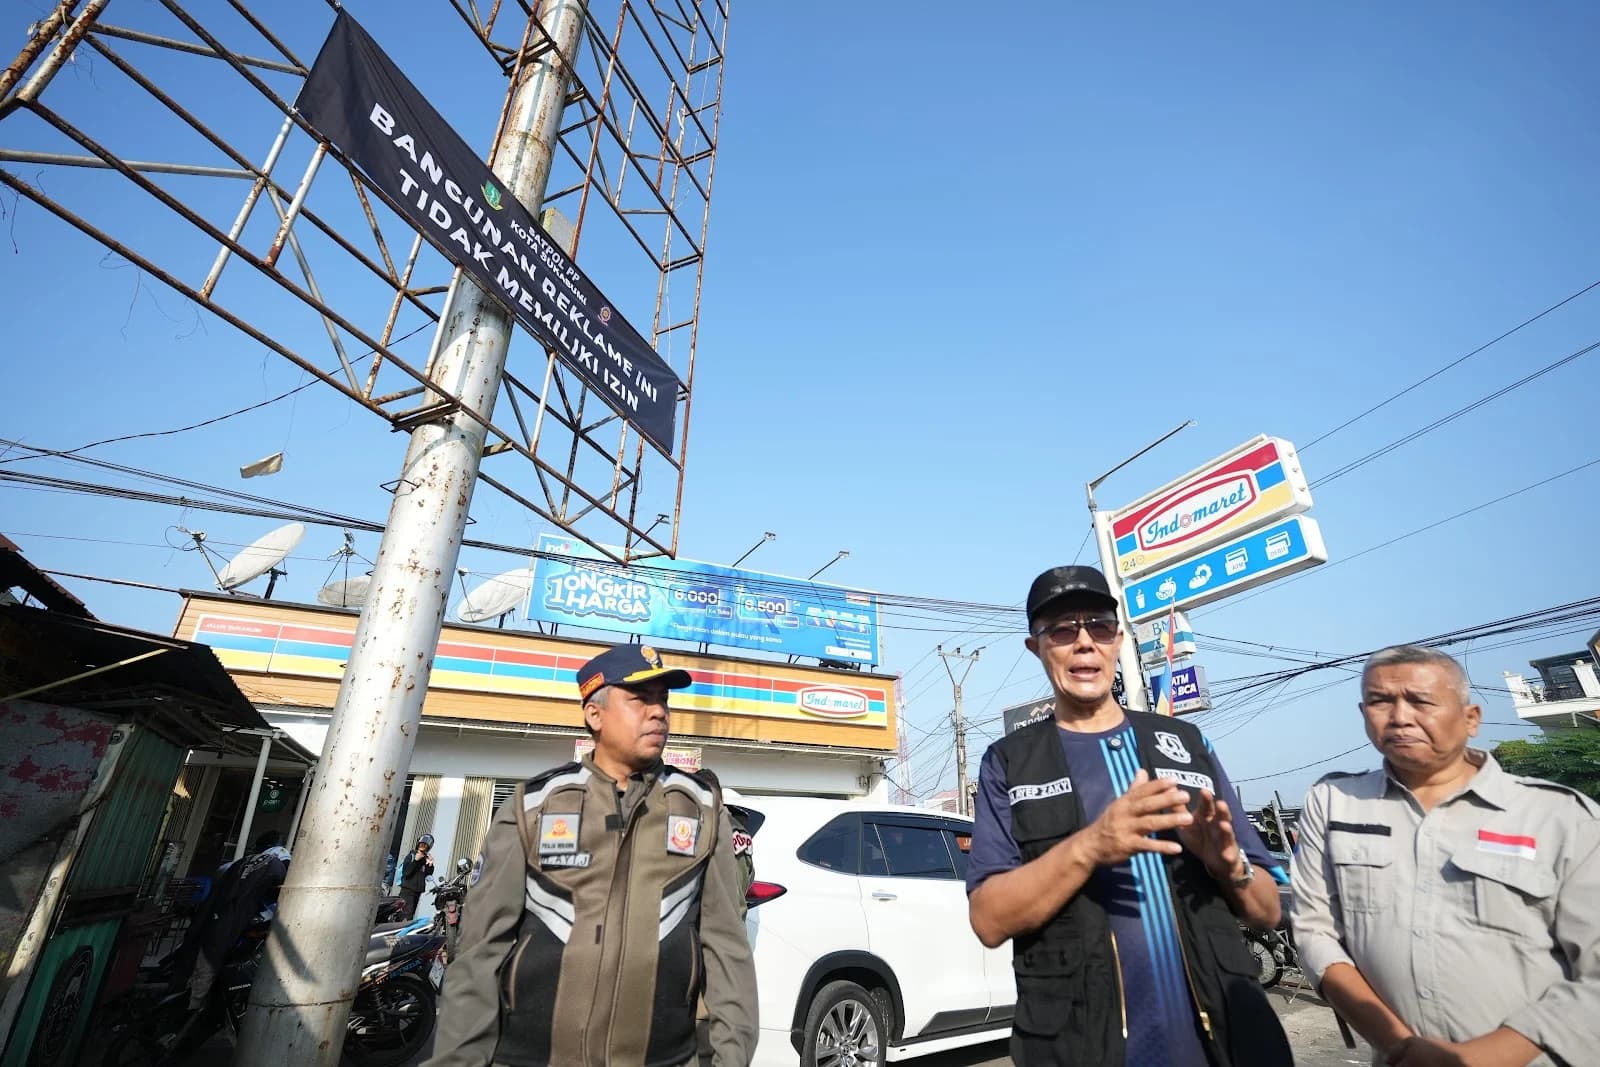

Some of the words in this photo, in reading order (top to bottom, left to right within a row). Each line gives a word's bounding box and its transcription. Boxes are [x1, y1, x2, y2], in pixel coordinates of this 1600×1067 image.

[510, 219, 538, 254] KOTA
[540, 251, 588, 306] SUKABUMI
[528, 226, 564, 270] SATPOL
[566, 266, 580, 281] PP
[398, 169, 496, 272] TIDAK
[495, 264, 600, 376] MEMILIKI
[602, 369, 639, 413] IZIN
[542, 277, 634, 377] REKLAME
[636, 368, 657, 403] INI
[1145, 482, 1247, 544] Indomaret
[564, 571, 648, 600] ONGKIR
[565, 590, 648, 616] HARGA
[1171, 673, 1190, 686] ATM
[1177, 684, 1197, 697] BCA
[806, 693, 863, 709] Indmaret
[1041, 780, 1069, 796] ZAKY
